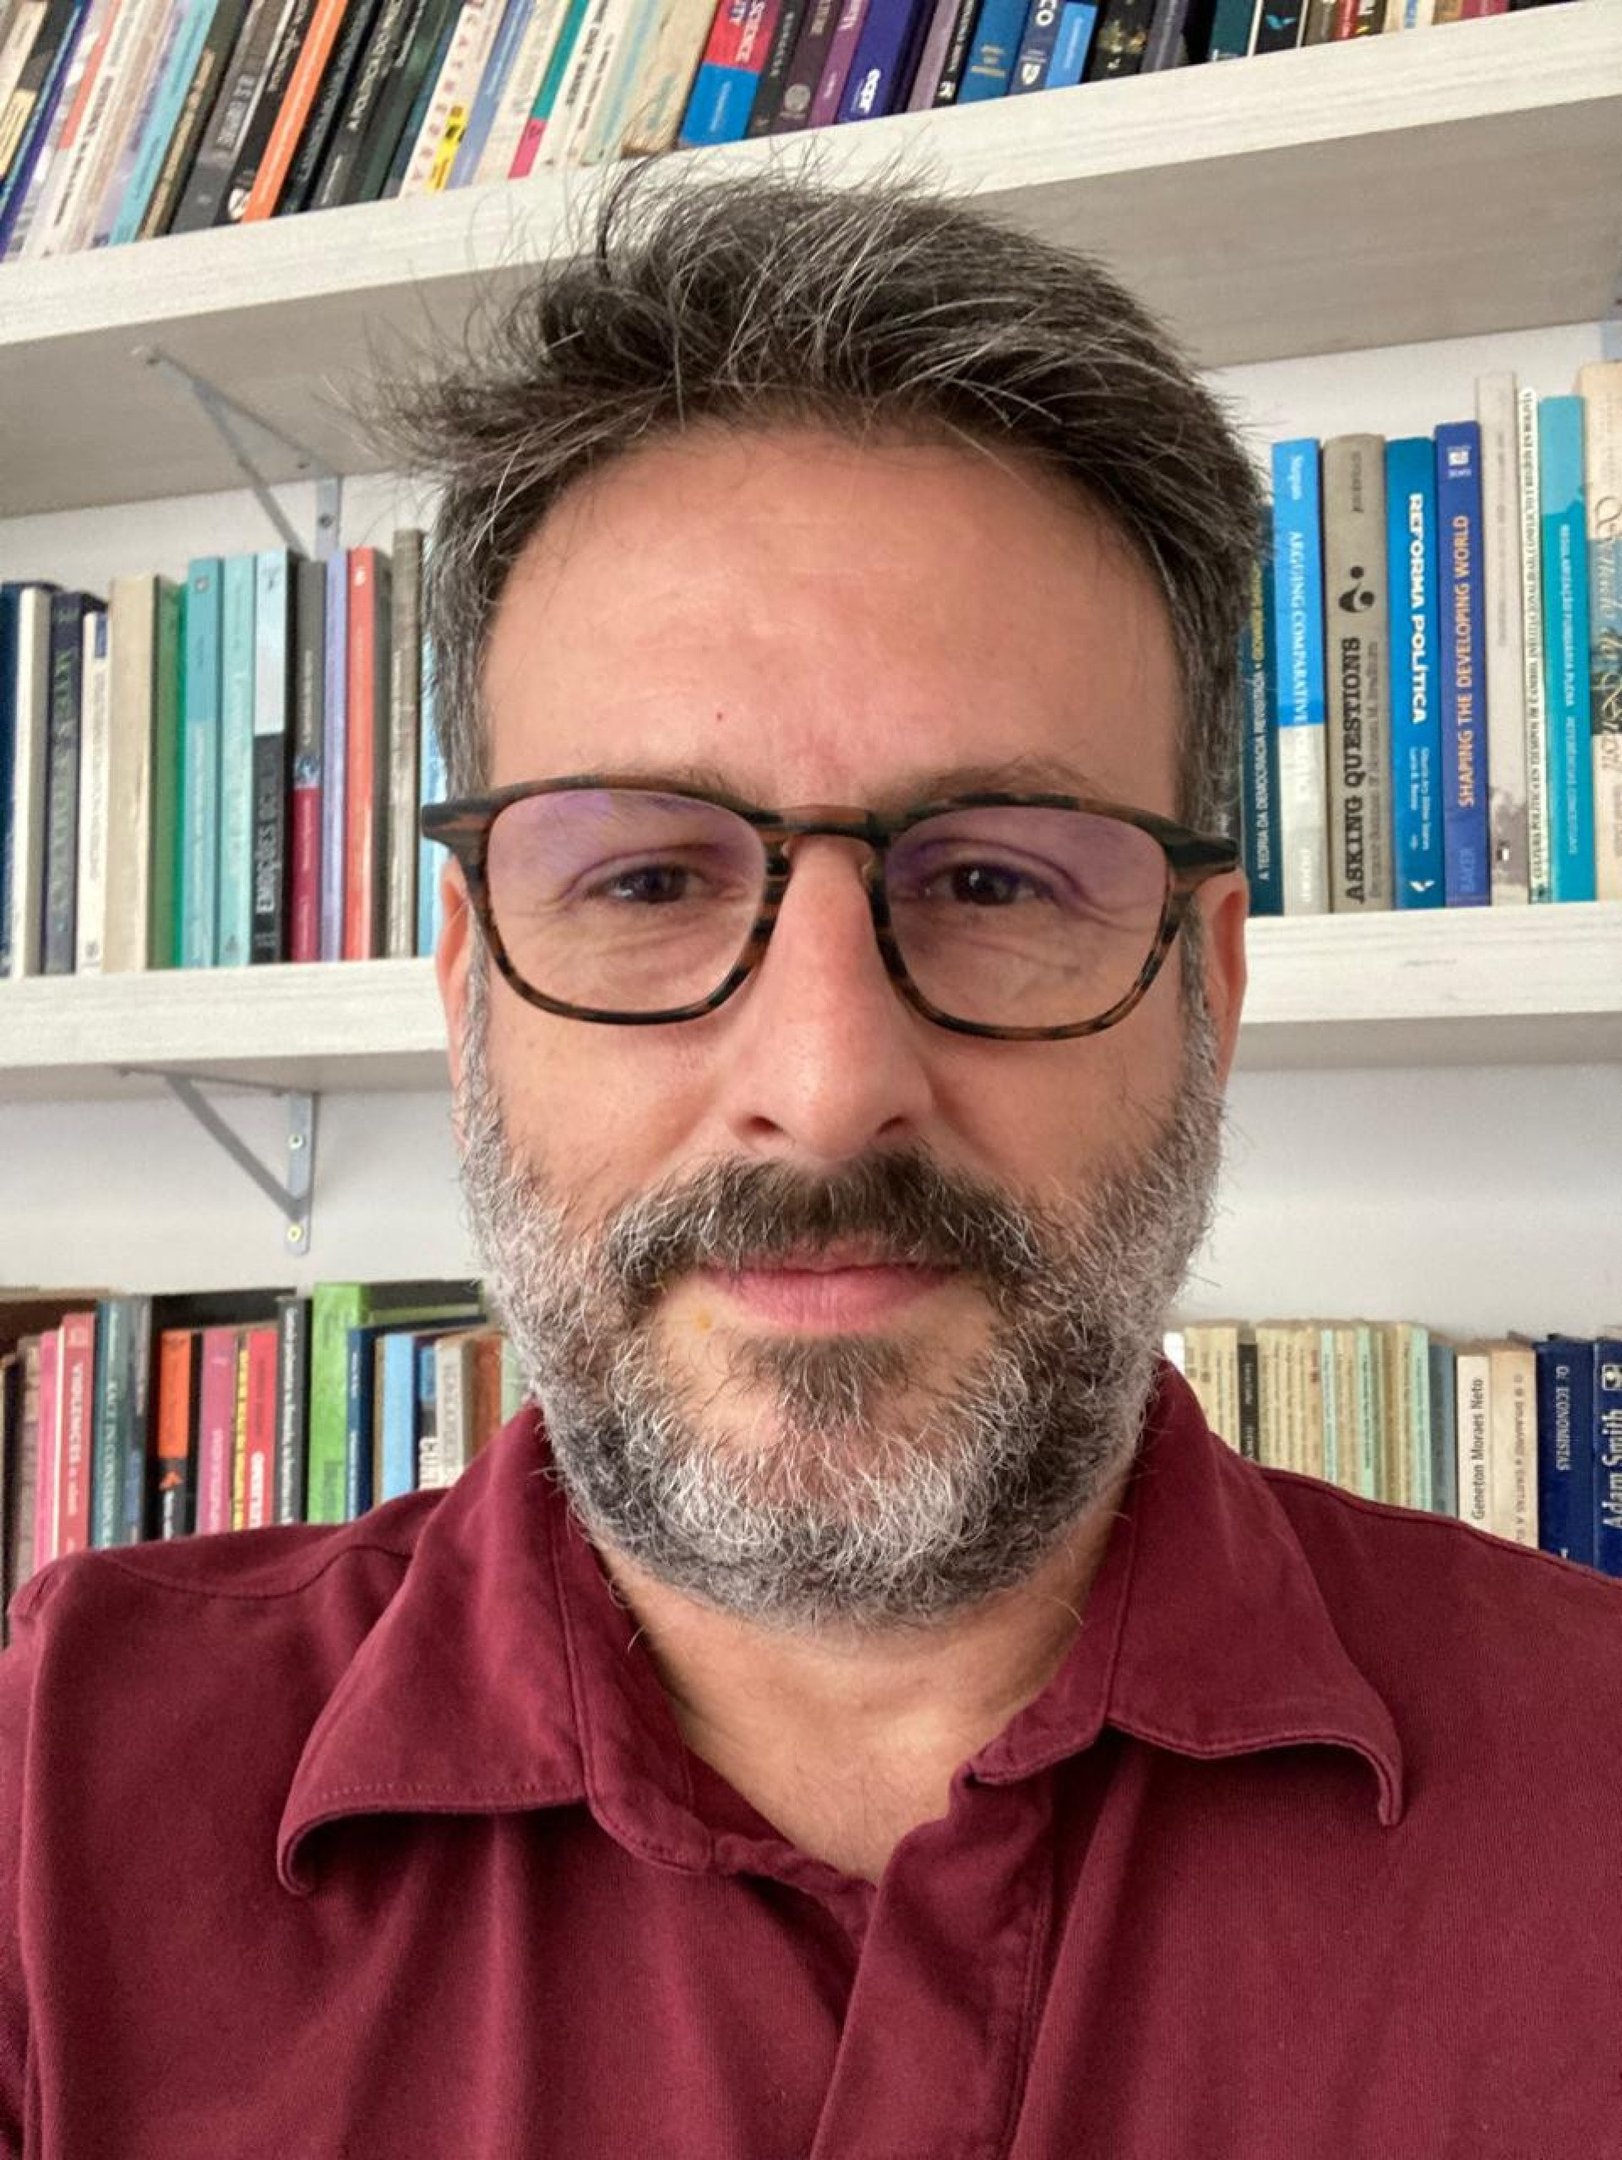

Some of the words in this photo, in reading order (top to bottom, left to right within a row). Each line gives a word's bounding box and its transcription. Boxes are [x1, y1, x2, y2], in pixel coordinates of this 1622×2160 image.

[1409, 493, 1425, 608] REFORMA
[1453, 515, 1471, 578] WORLD
[1291, 609, 1307, 725] COMPARATIVE
[1411, 614, 1428, 724] POLÍTICA
[1454, 582, 1473, 688] DEVELOPING
[1342, 637, 1366, 788] QUESTIONS
[1456, 692, 1473, 725] THE
[1255, 736, 1268, 808] DEMOCRACIA
[1457, 730, 1475, 808] SHAPING
[1256, 811, 1268, 827] DA
[1257, 837, 1269, 870] TEORIA
[1345, 796, 1365, 904] ASKING
[254, 824, 282, 915] EMOÇÕES
[1469, 1377, 1484, 1410] Neto
[1555, 1386, 1572, 1471] ECONOMISTAS
[1470, 1413, 1485, 1461] Moraes
[1601, 1408, 1622, 1468] Smith
[1471, 1464, 1486, 1520] Geneton
[1601, 1472, 1622, 1529] Adam
